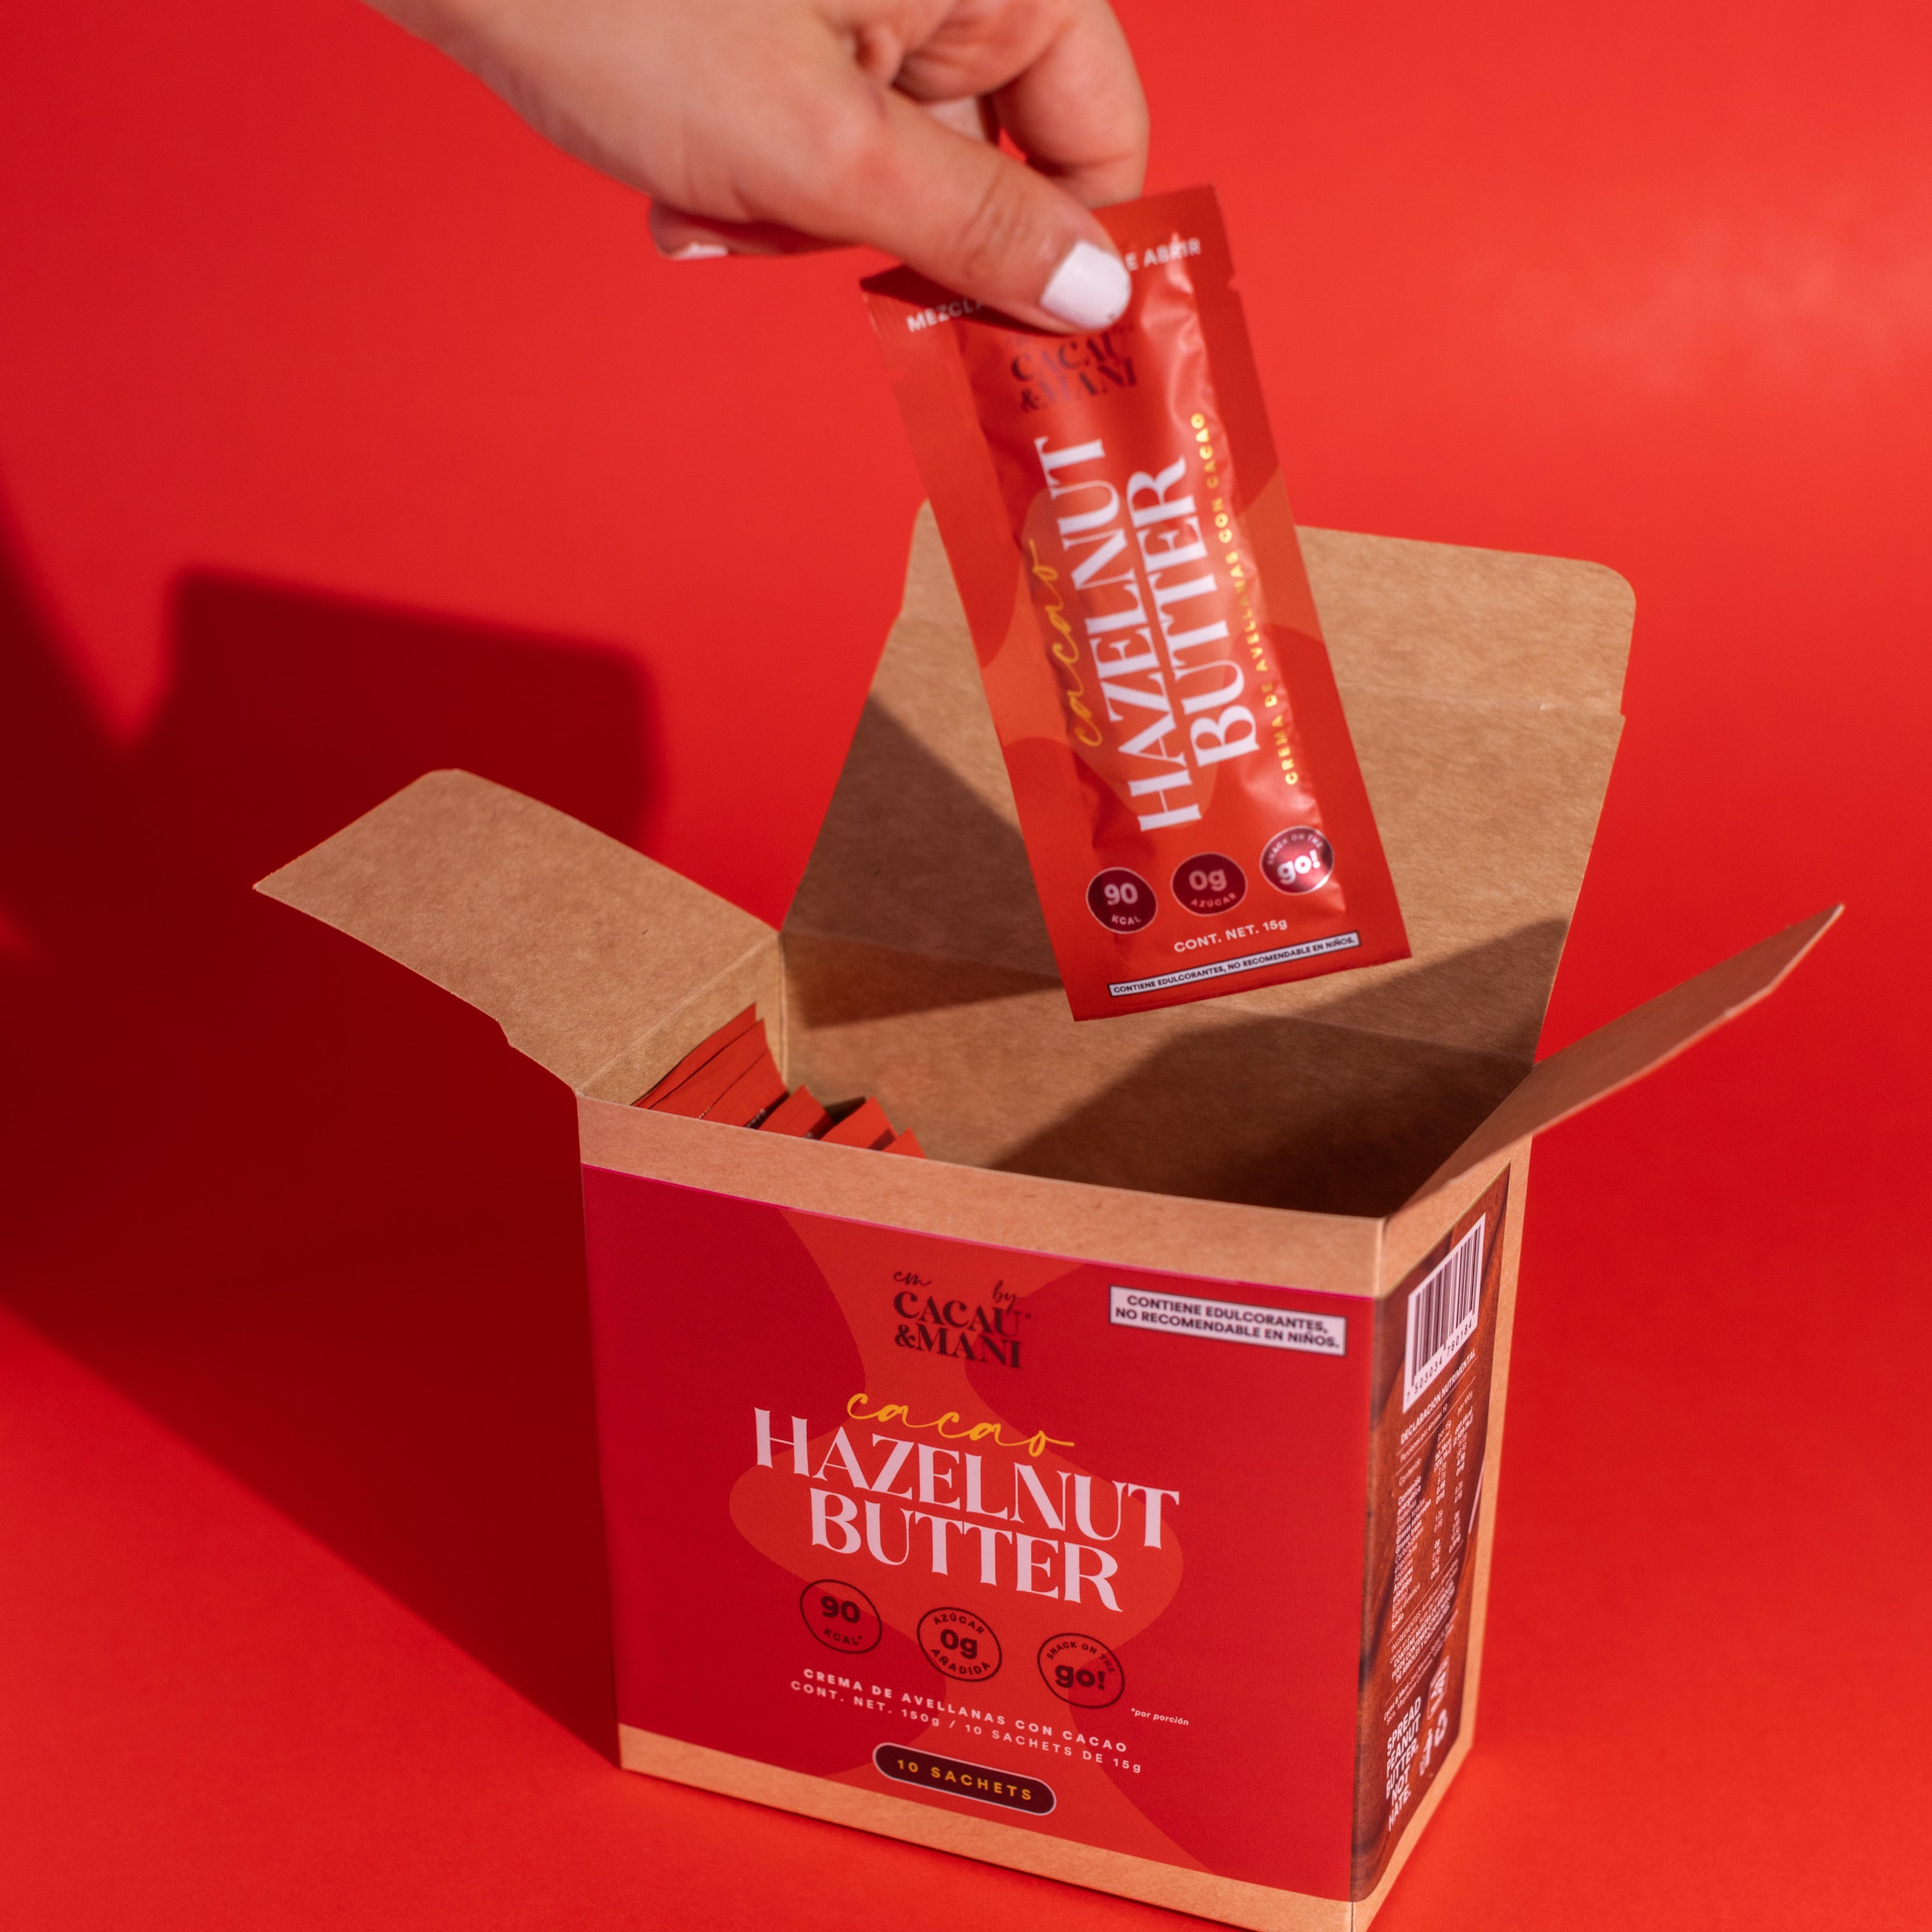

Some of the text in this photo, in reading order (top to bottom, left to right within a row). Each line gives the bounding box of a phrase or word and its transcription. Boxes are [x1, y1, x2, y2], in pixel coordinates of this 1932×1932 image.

[1143, 238, 1201, 267] ABRIR
[1126, 455, 1260, 766] BUTTER
[1191, 412, 1298, 785] CREMA DE AVELLANAS CON CACAO
[1028, 540, 1103, 746] cacao
[1035, 435, 1202, 831] HAZELNUT
[1189, 869, 1227, 891] 0g
[1277, 849, 1321, 885] go!
[1104, 882, 1139, 905] 90
[1191, 893, 1237, 909] AZÚCAR
[1111, 914, 1142, 925] KCAL
[1174, 919, 1287, 953] CONT. NET. 15g
[1113, 934, 1356, 993] CONTIENE EDULCORANTES, NO RECOMENDABLE EN NIÑOS.
[894, 1291, 1021, 1338] CACAU
[1115, 1307, 1340, 1348] NO RECOMENDABLE EN NIÑOS.
[1128, 1295, 1328, 1332] CONTIENE EDULCORANTES,
[895, 1323, 1021, 1369] &MANI
[1414, 1353, 1443, 1394] 503034
[1446, 1318, 1472, 1358] 760184
[1400, 1390, 1441, 1446] DECLARACIÓN
[1441, 1345, 1476, 1399] NUTRIMENTAL
[847, 1393, 1075, 1457] cacao
[754, 1407, 1180, 1549] HAZELNUT
[810, 1487, 1123, 1613] BUTTER
[820, 1596, 860, 1623] 90
[933, 1612, 984, 1634] AZÚCAR
[931, 1648, 990, 1674] AÑADIDA
[940, 1629, 978, 1659] 0g
[1046, 1641, 1115, 1674] SNACK ON THE
[1055, 1665, 1106, 1690] go!
[791, 1681, 844, 1701] CONT.
[853, 1696, 892, 1714] NET.
[902, 1709, 940, 1727] 150g
[965, 1724, 982, 1736] 10
[992, 1730, 1072, 1757] SACHETS
[1083, 1750, 1103, 1763] DE
[1113, 1757, 1141, 1774] 15g
[803, 1668, 1127, 1752] CREMA DE AVELLANAS CON CACAO
[1153, 1712, 1189, 1726] porción
[1387, 1692, 1421, 1758] SPREAD
[1385, 1732, 1419, 1801] BUTTER.
[1386, 1710, 1421, 1780] PEANUT
[897, 1759, 1032, 1800] 10 SACHETS
[1391, 1762, 1410, 1808] NOT
[1388, 1779, 1412, 1834] HATE.
